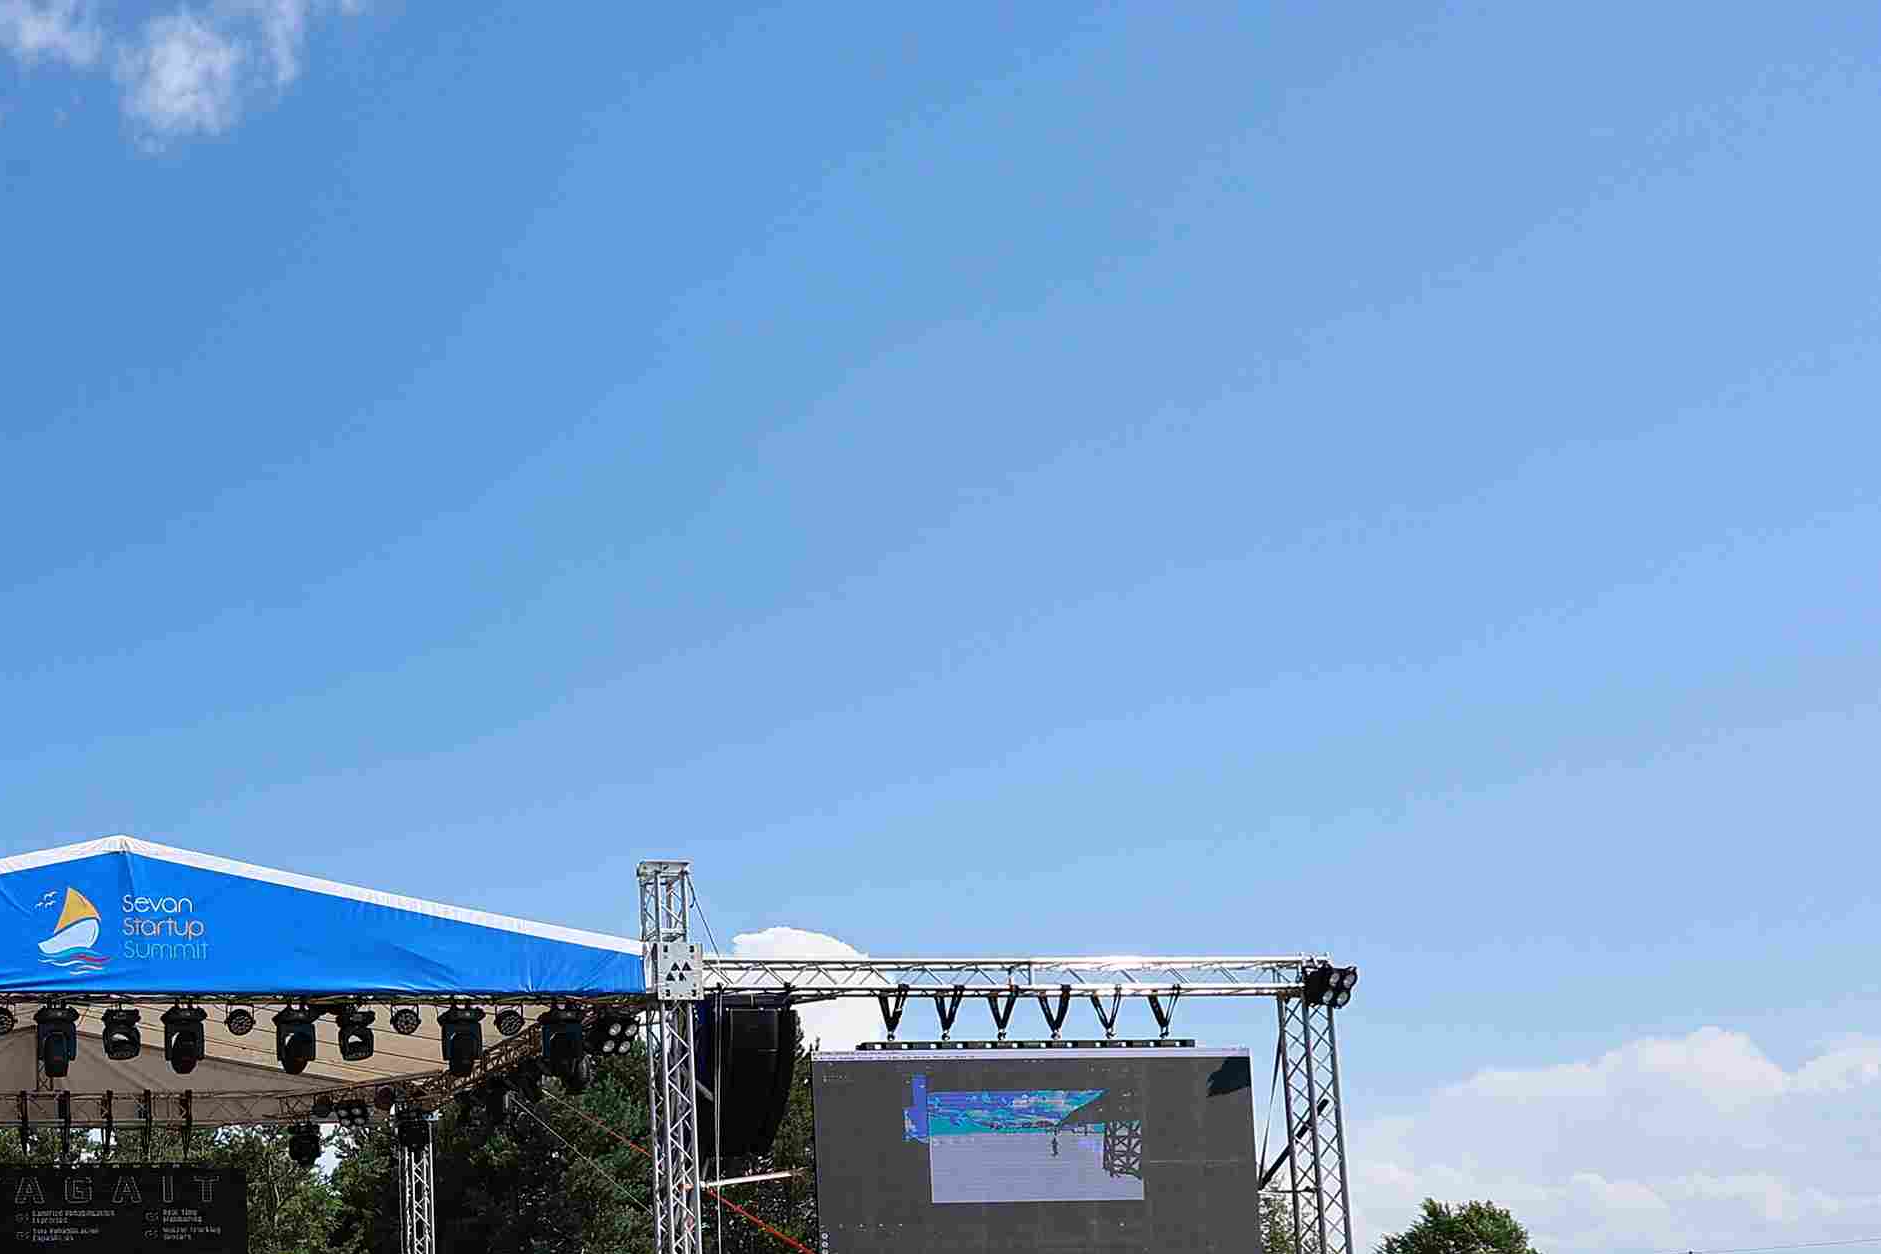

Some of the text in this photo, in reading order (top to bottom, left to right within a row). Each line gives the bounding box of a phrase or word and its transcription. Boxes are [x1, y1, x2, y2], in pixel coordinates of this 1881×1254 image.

[122, 894, 194, 913] Sevan
[122, 916, 205, 940] Startup
[124, 940, 208, 960] Summit
